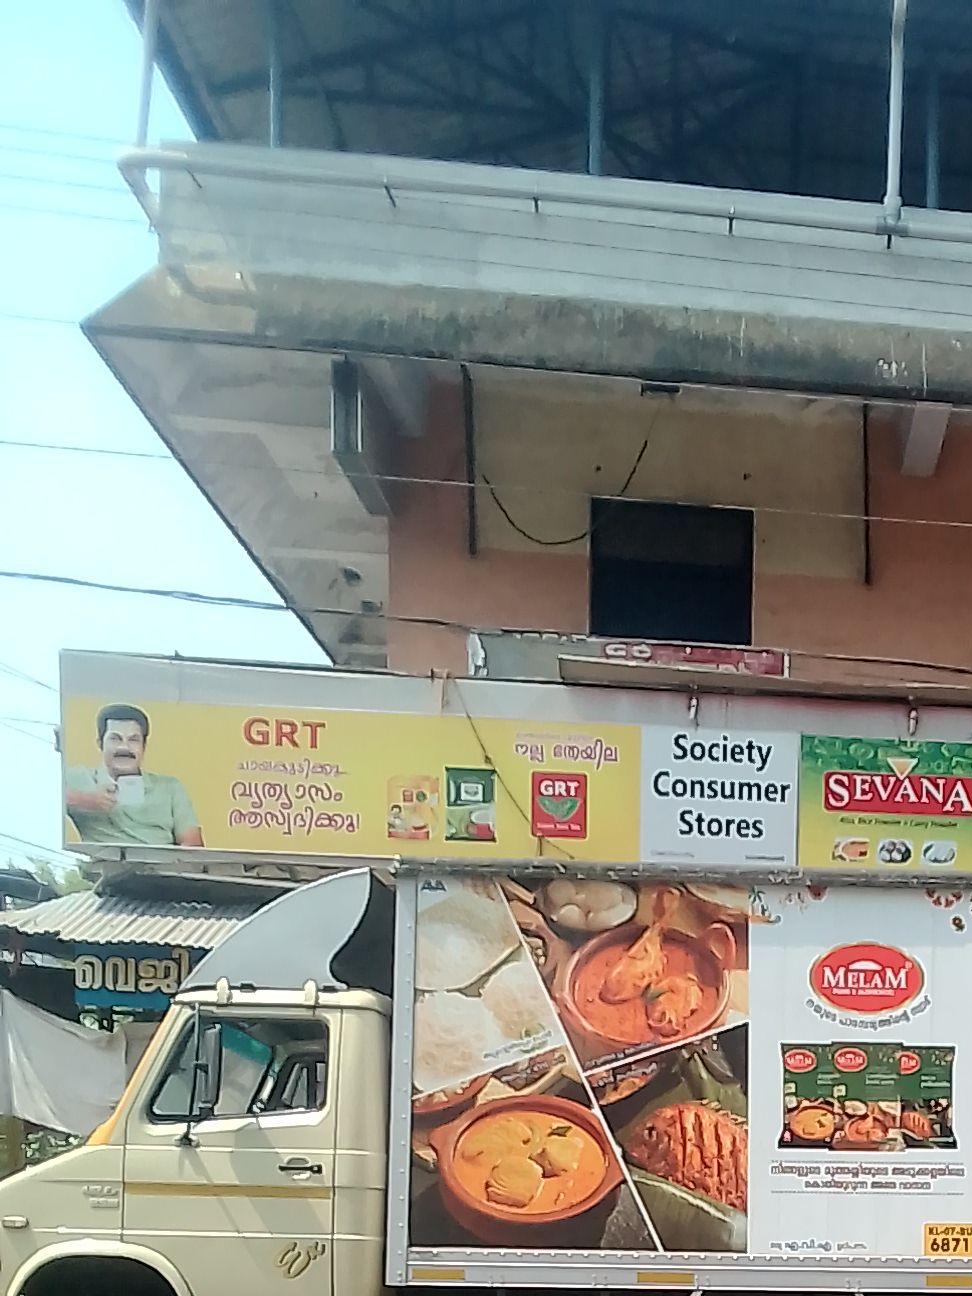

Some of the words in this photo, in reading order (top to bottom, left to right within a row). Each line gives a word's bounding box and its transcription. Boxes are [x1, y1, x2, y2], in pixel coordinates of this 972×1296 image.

[242, 716, 327, 750] GRT
[515, 743, 544, 763] നല്ല
[553, 738, 618, 770] തേയില
[672, 733, 773, 772] Society
[231, 781, 343, 810] വ്യത്യാസം
[539, 779, 580, 797] GRT
[653, 770, 791, 804] Consumer
[678, 809, 764, 839] Stores
[821, 966, 908, 989] MELAM
[930, 1237, 969, 1253] 6871
